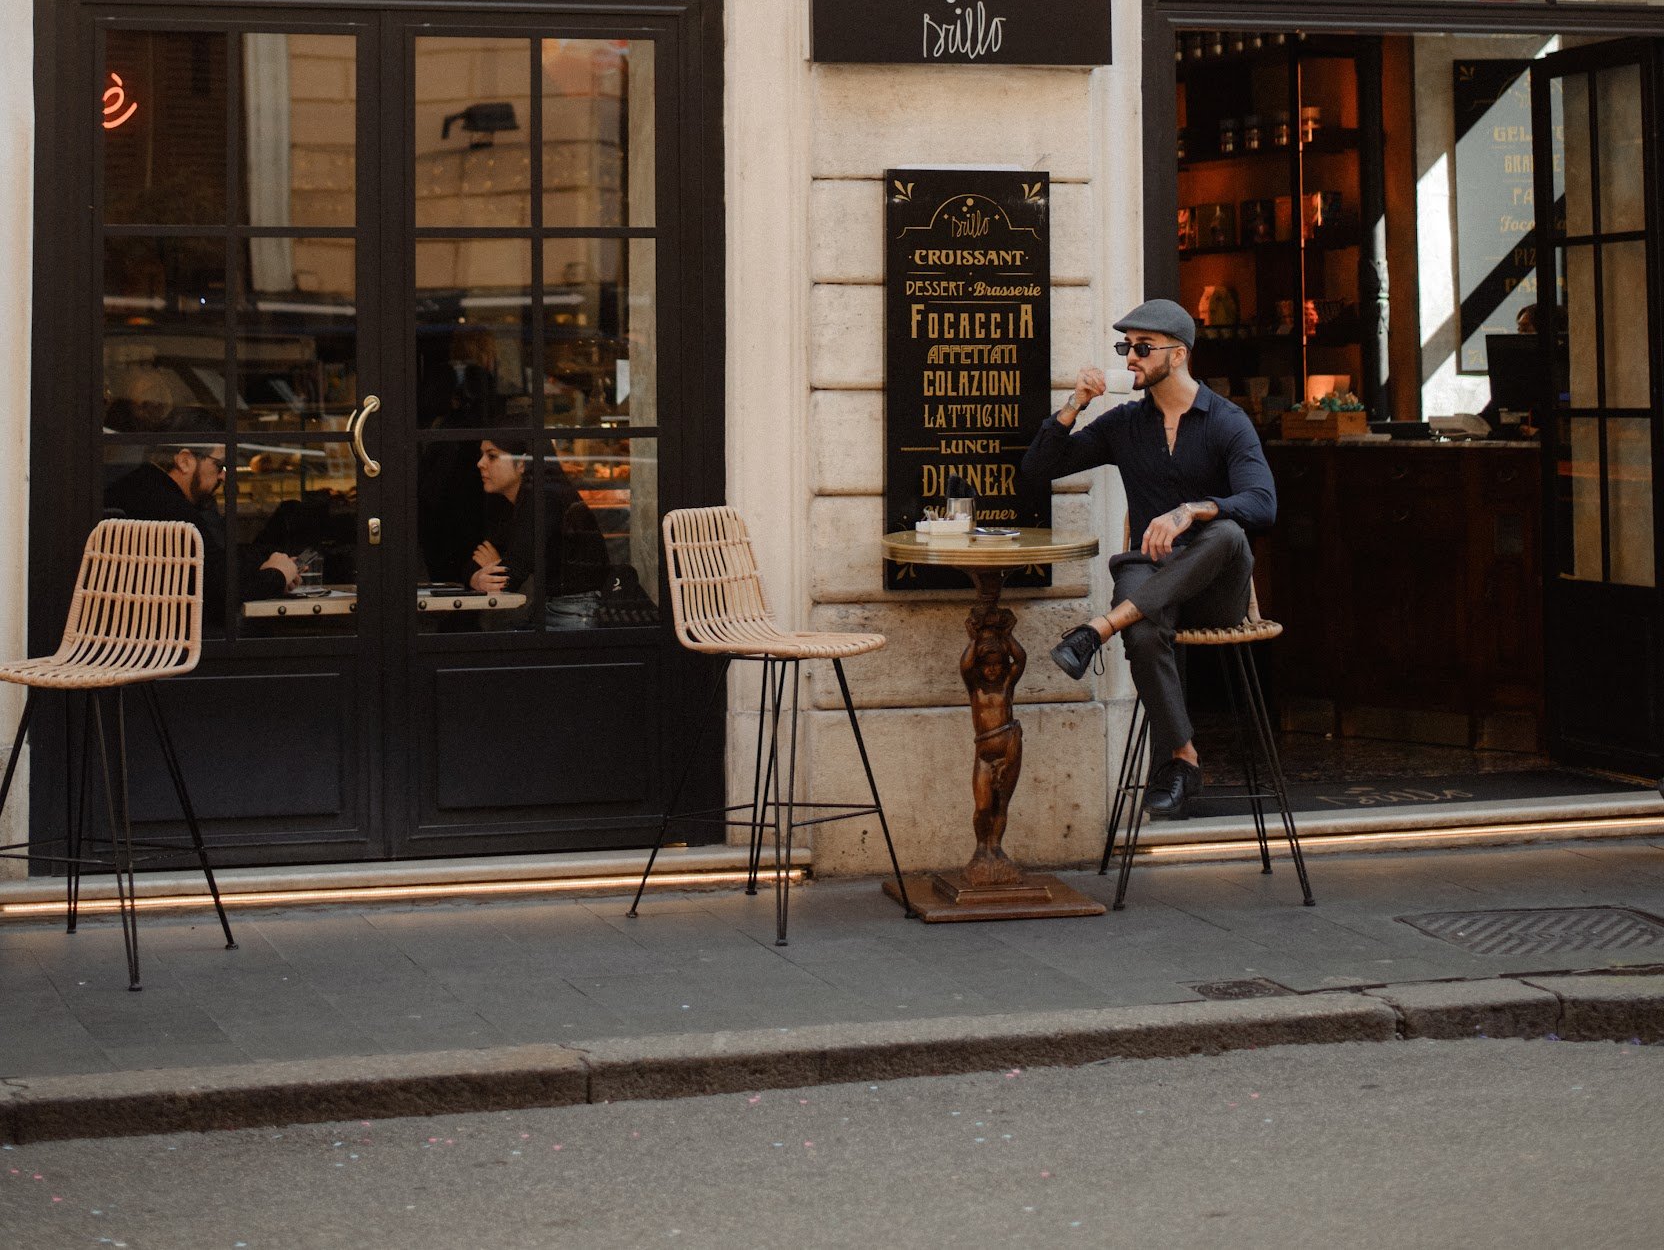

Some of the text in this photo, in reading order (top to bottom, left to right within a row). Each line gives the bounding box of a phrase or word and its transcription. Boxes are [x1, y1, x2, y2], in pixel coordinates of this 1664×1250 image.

[923, 1, 1006, 59] Brillo
[951, 210, 991, 238] Brillo
[914, 250, 1024, 266] CROISSANT
[906, 281, 1042, 297] DESSERT Brasserie
[927, 344, 1018, 364] AFFETTATI
[923, 370, 1021, 396] COLAZIONI
[923, 404, 1020, 428] LATTICINI
[940, 439, 1001, 454] LUNCH
